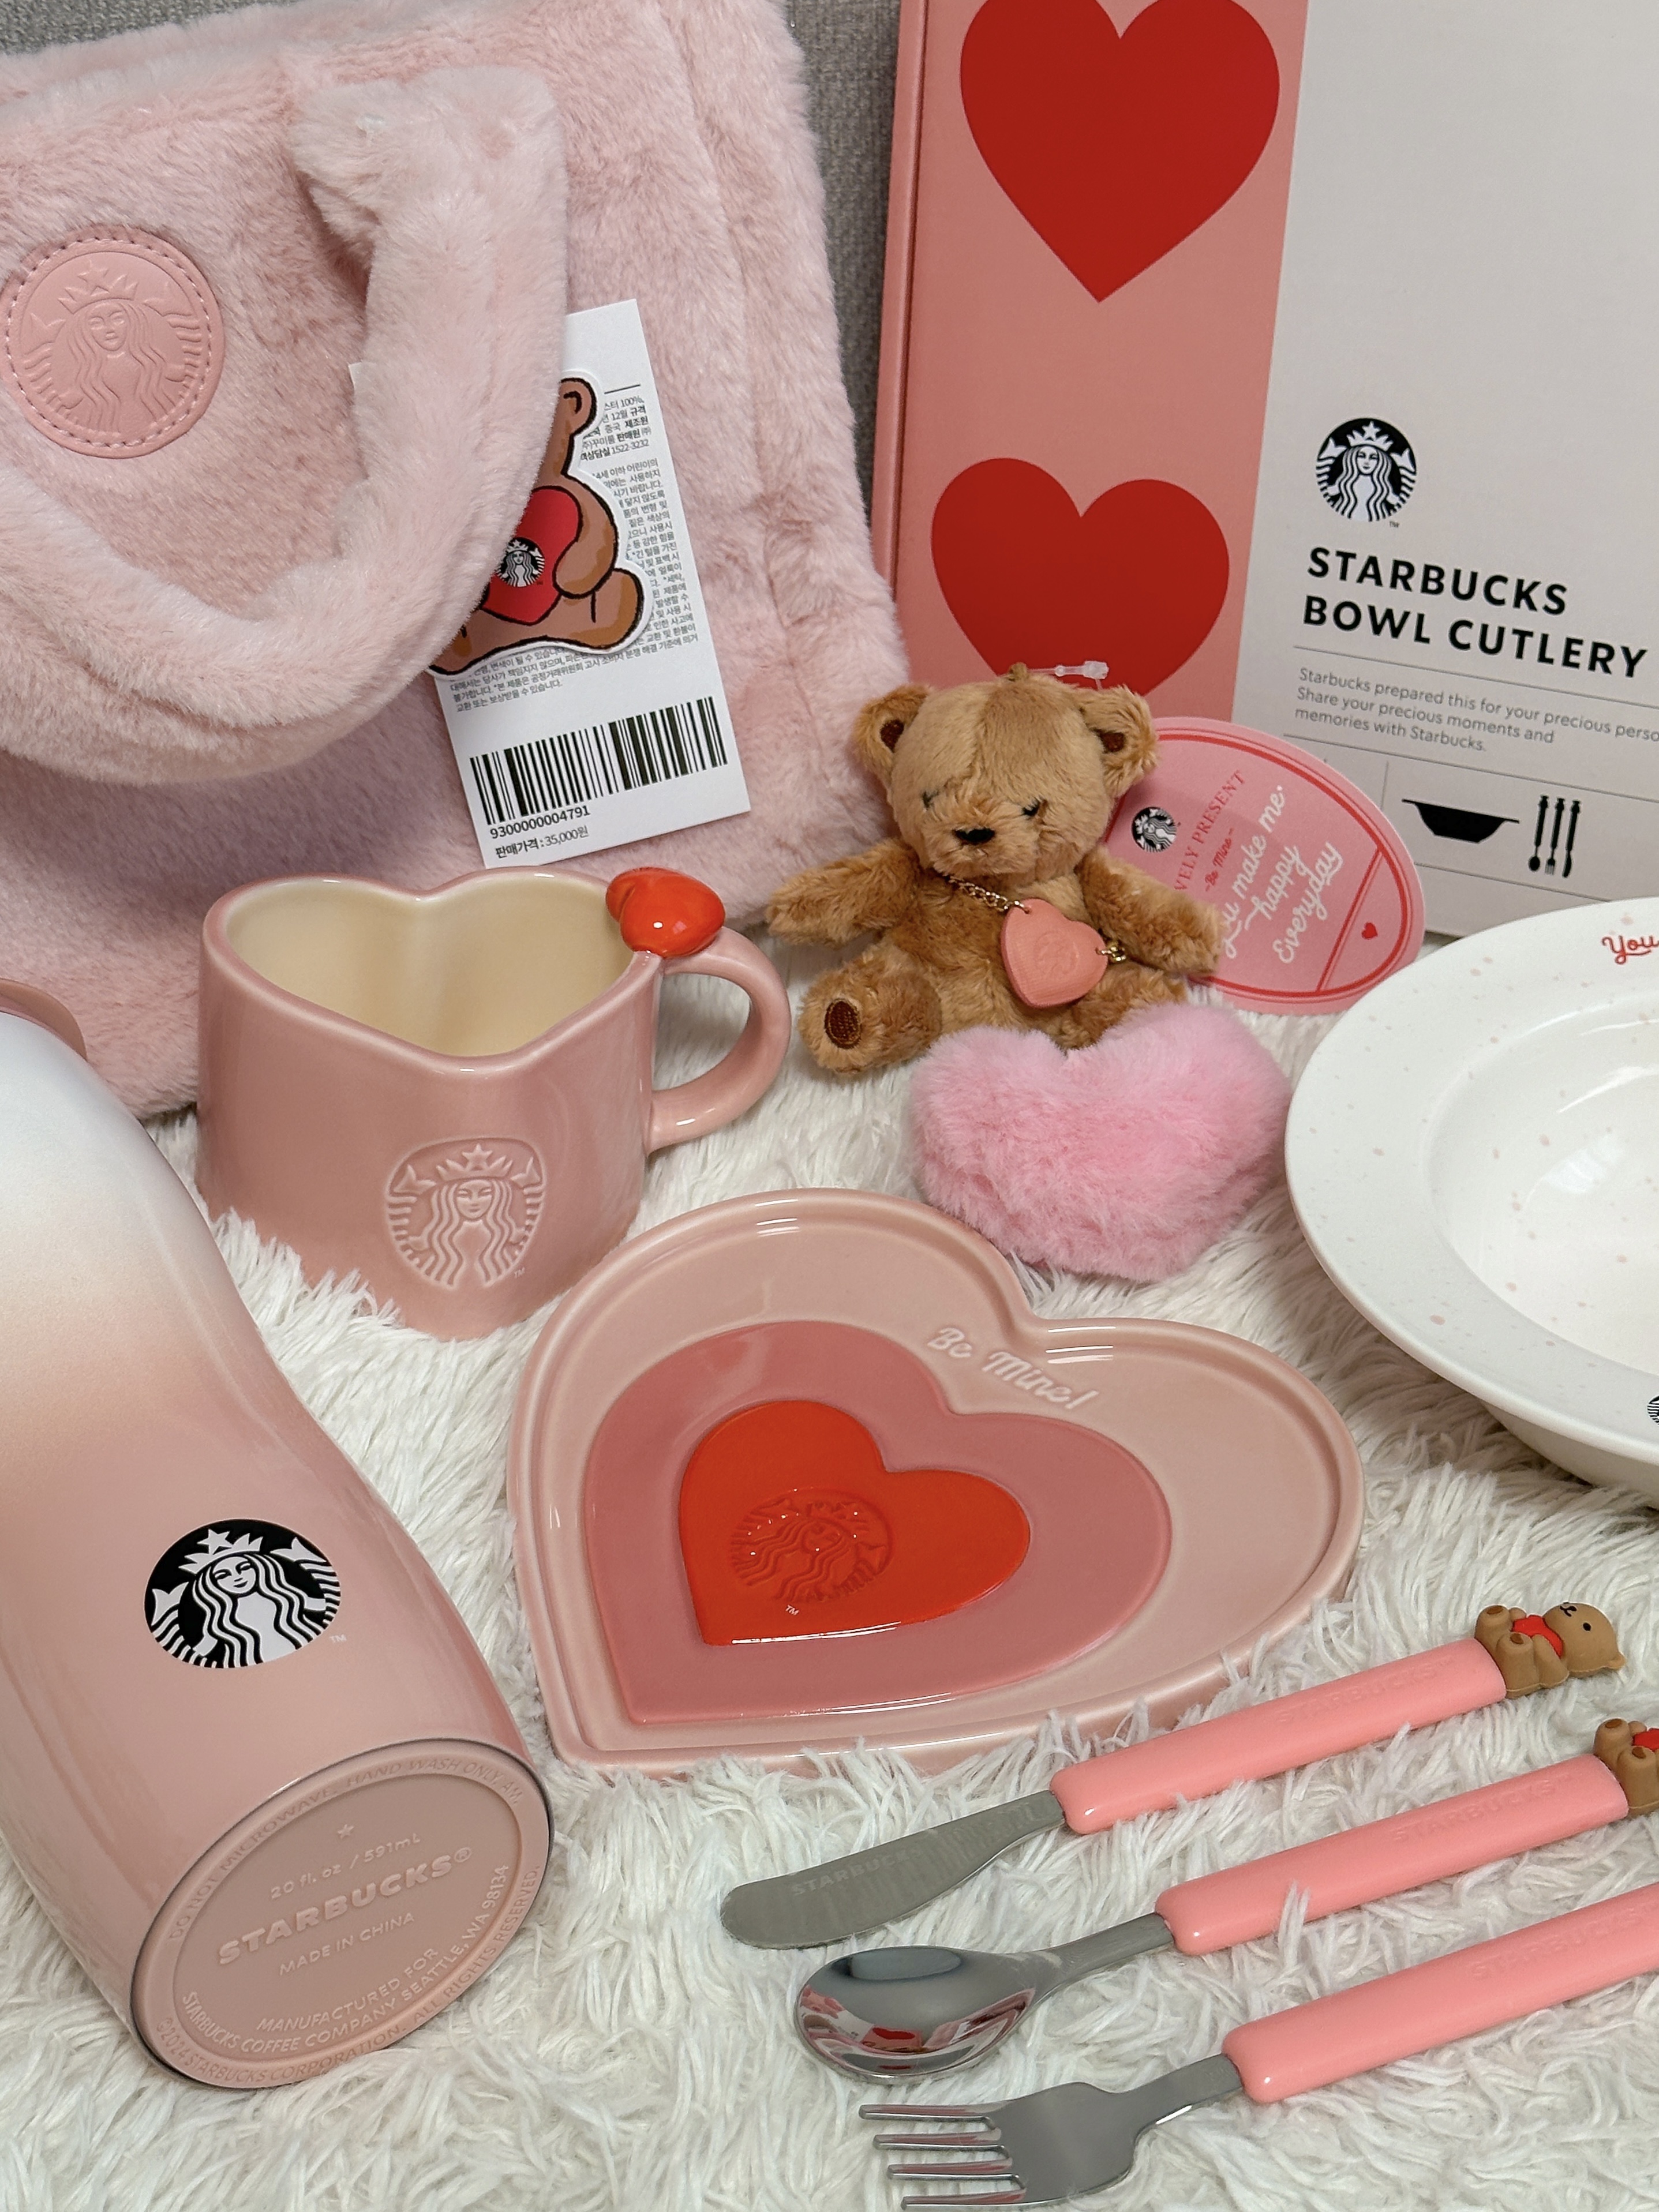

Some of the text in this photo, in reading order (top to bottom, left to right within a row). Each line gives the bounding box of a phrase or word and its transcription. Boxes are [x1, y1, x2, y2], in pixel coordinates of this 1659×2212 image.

[604, 400, 619, 411] 스터
[631, 405, 646, 416] 규격
[616, 429, 641, 442] 판매원
[625, 416, 648, 428] 제조원
[581, 439, 649, 460] 객상담실 1522-3232
[592, 458, 658, 479] 4세 이하 어린이의
[630, 468, 661, 482] 사용하지
[613, 487, 628, 497] 시기
[641, 490, 665, 503] 않도록
[623, 507, 639, 518] 품의
[659, 500, 667, 509] 및
[647, 511, 670, 522] 색상의
[655, 554, 671, 565] 표백
[661, 541, 677, 552] 가진
[664, 583, 687, 594] 제품에
[1307, 546, 1567, 615] STARBUCKS
[656, 593, 688, 608] 발생할 수
[666, 605, 681, 615] 사용
[683, 602, 691, 611] 시
[525, 654, 533, 662] 수
[671, 613, 694, 625] 사고에
[1303, 595, 1647, 678] BOWL CUTLERY
[482, 672, 505, 684] 당사가
[507, 663, 538, 676] 책임지지
[539, 657, 565, 670] 않으며,
[507, 677, 529, 688] 제품은
[531, 663, 583, 683] 공정거래위원회
[585, 658, 600, 669] 고시
[659, 638, 681, 649] 기준에
[683, 633, 698, 643] 의거
[456, 702, 471, 712] 교환
[472, 699, 488, 708] 또는
[489, 689, 519, 703] 보상받을
[529, 679, 562, 694] 있습니다.
[1299, 667, 1370, 692] Starbucks
[1374, 682, 1443, 704] prepared
[1448, 692, 1476, 710] this
[1480, 697, 1501, 714] for
[1504, 706, 1540, 720] your
[1544, 712, 1611, 733] precious
[1294, 707, 1486, 751] memories with Starbucks.
[1297, 687, 1555, 744] Share your precious moments and
[490, 806, 589, 838] 9300000004791
[1174, 770, 1246, 891] VELY PRESENT
[1231, 834, 1267, 900] make
[1244, 845, 1308, 931] happy
[1272, 841, 1345, 963] Everyday
[1601, 935, 1659, 965] You
[927, 1327, 1099, 1409] Be Mine!
[187, 1876, 219, 1910] NOT
[347, 1761, 402, 1787] HAND
[410, 1757, 459, 1772] WASH
[271, 1880, 294, 1900] 20
[299, 1872, 317, 1887] fl.
[322, 1864, 342, 1878] oz
[364, 1832, 421, 1862] 591mL
[182, 1864, 509, 2053] STARBUCKS COFFEE COMPANY SEATTLE, WA 98134
[279, 1911, 415, 1977] MADE IN CHINA
[185, 2054, 266, 2082] STARBUCKS
[414, 1999, 441, 2023] ALL
[443, 1946, 497, 1999] RIGHTS
[493, 1865, 541, 1943] RESERVED.
[256, 1948, 439, 2032] MANUFACTURED FOR
